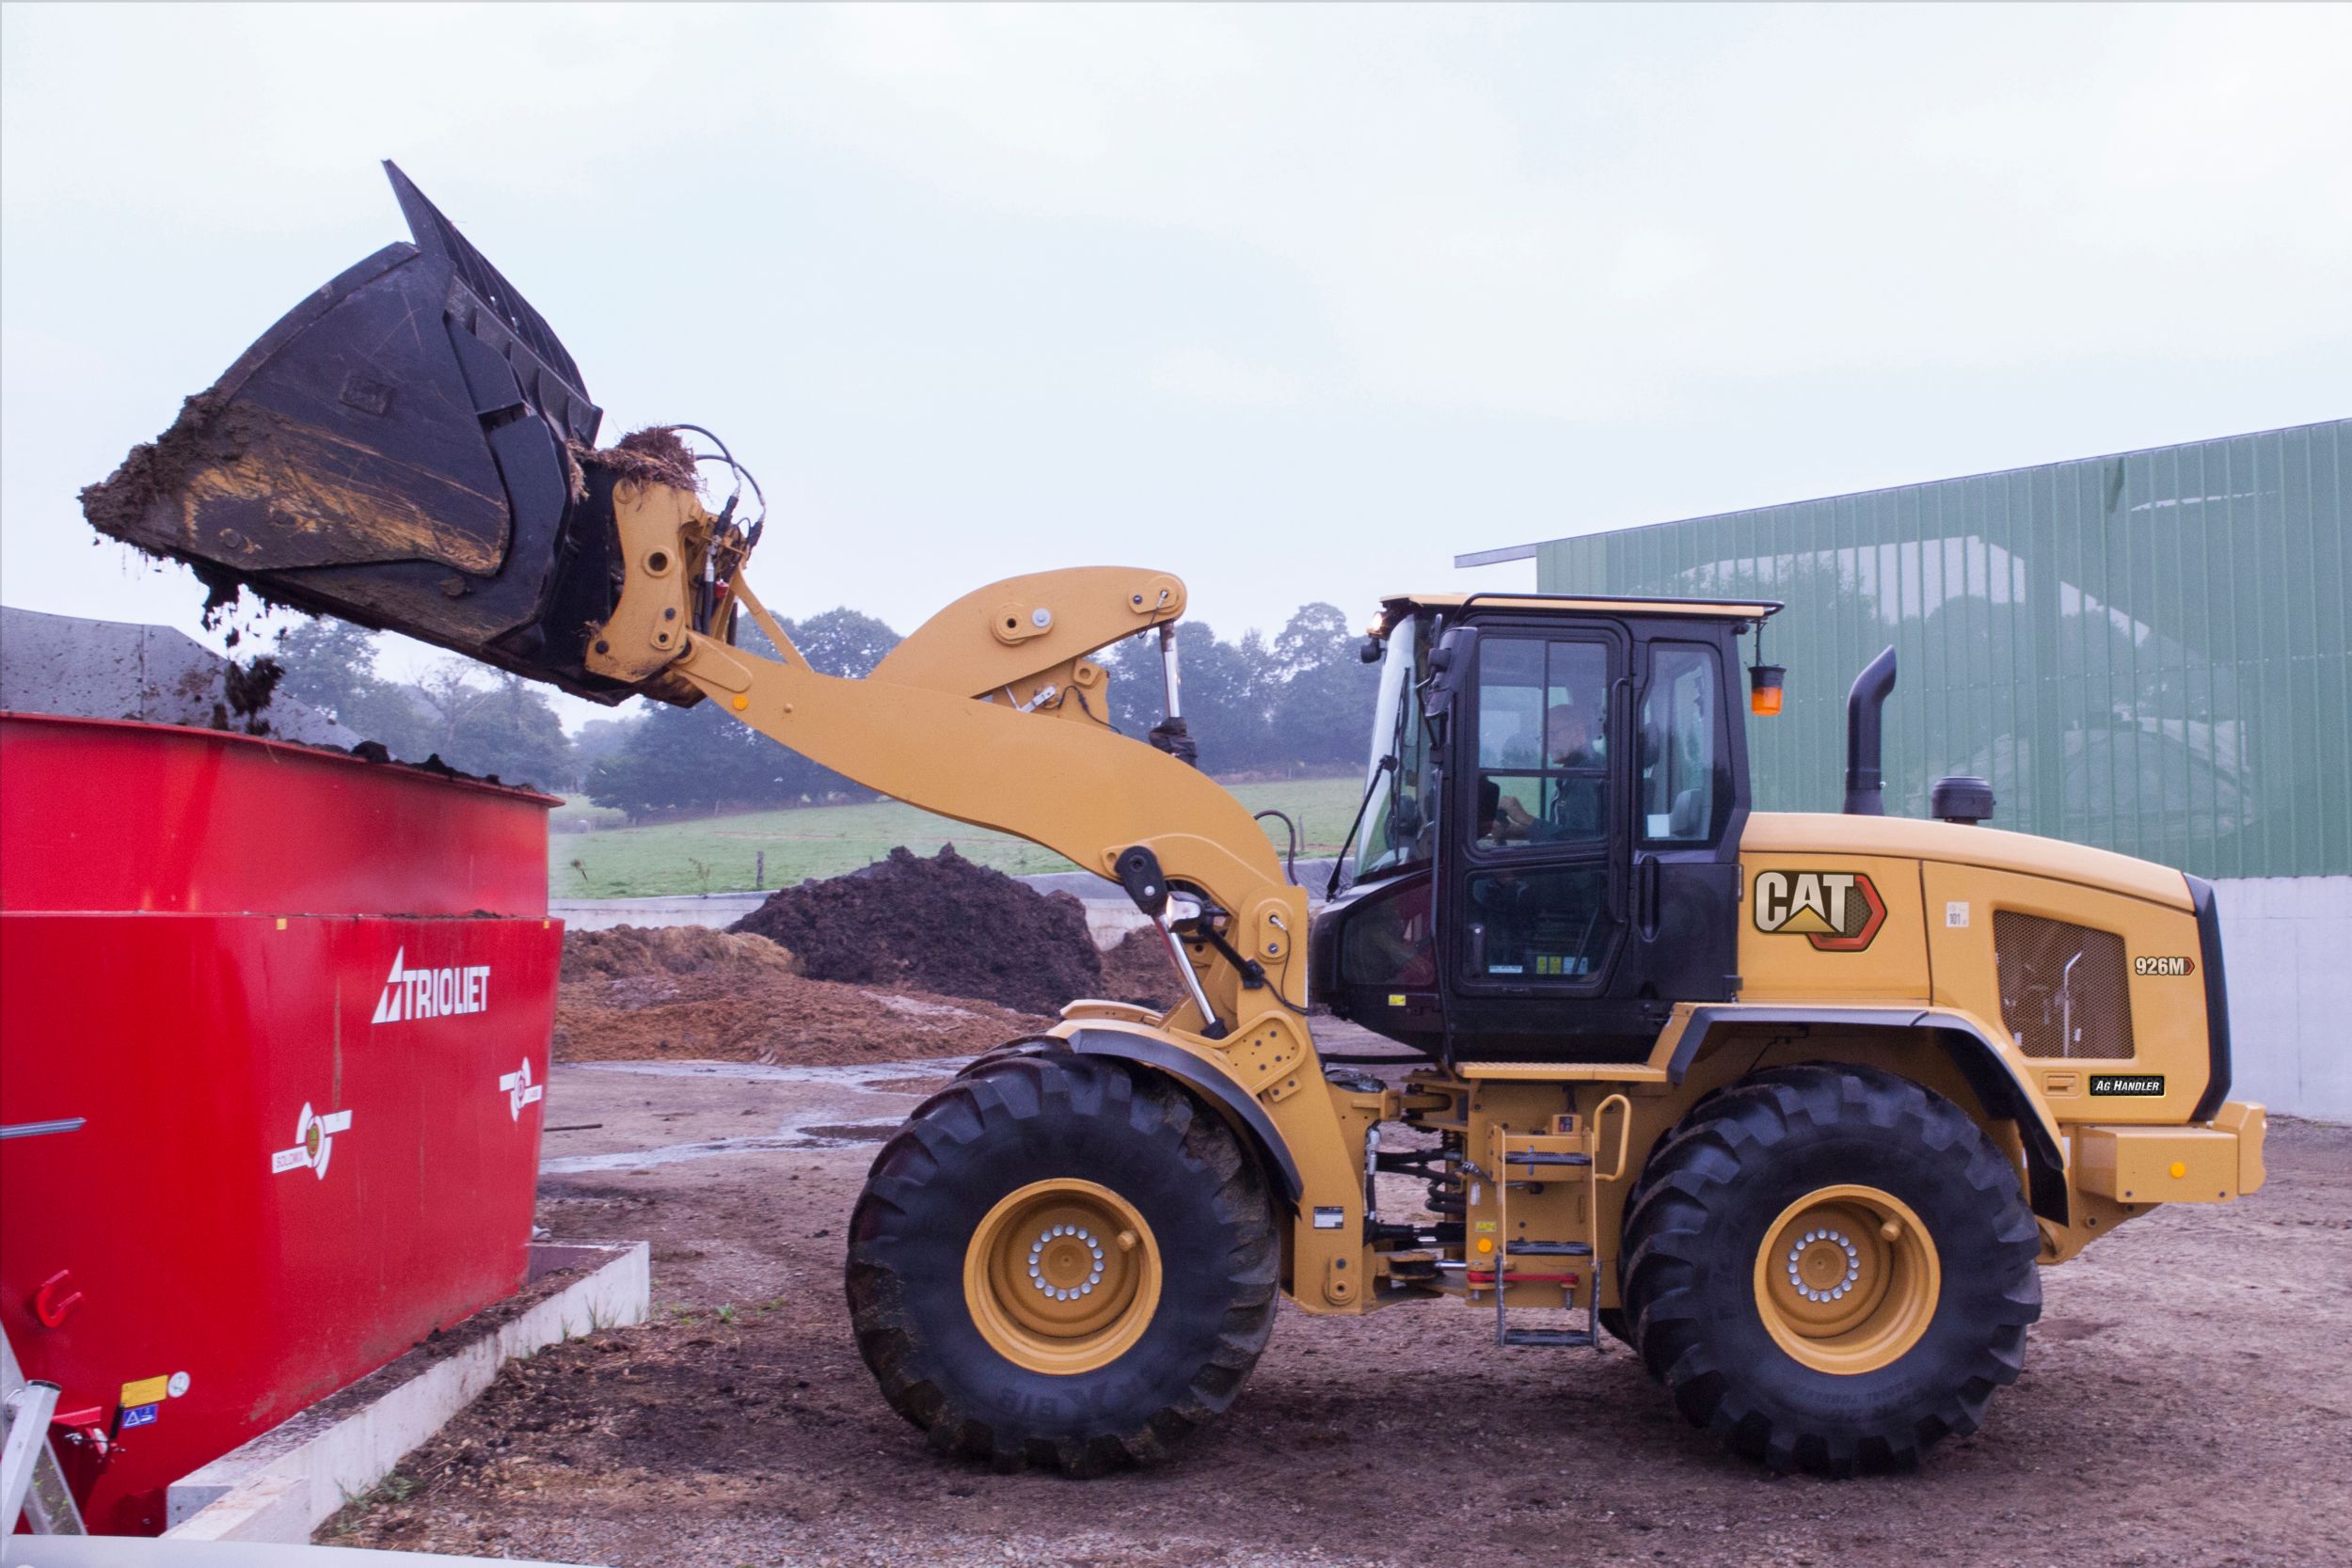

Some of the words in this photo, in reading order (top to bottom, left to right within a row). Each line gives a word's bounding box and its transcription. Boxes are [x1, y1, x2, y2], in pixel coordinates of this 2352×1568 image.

[1756, 872, 1854, 933] CAT
[403, 965, 490, 1021] TRIOLIET
[2135, 957, 2185, 975] 926M
